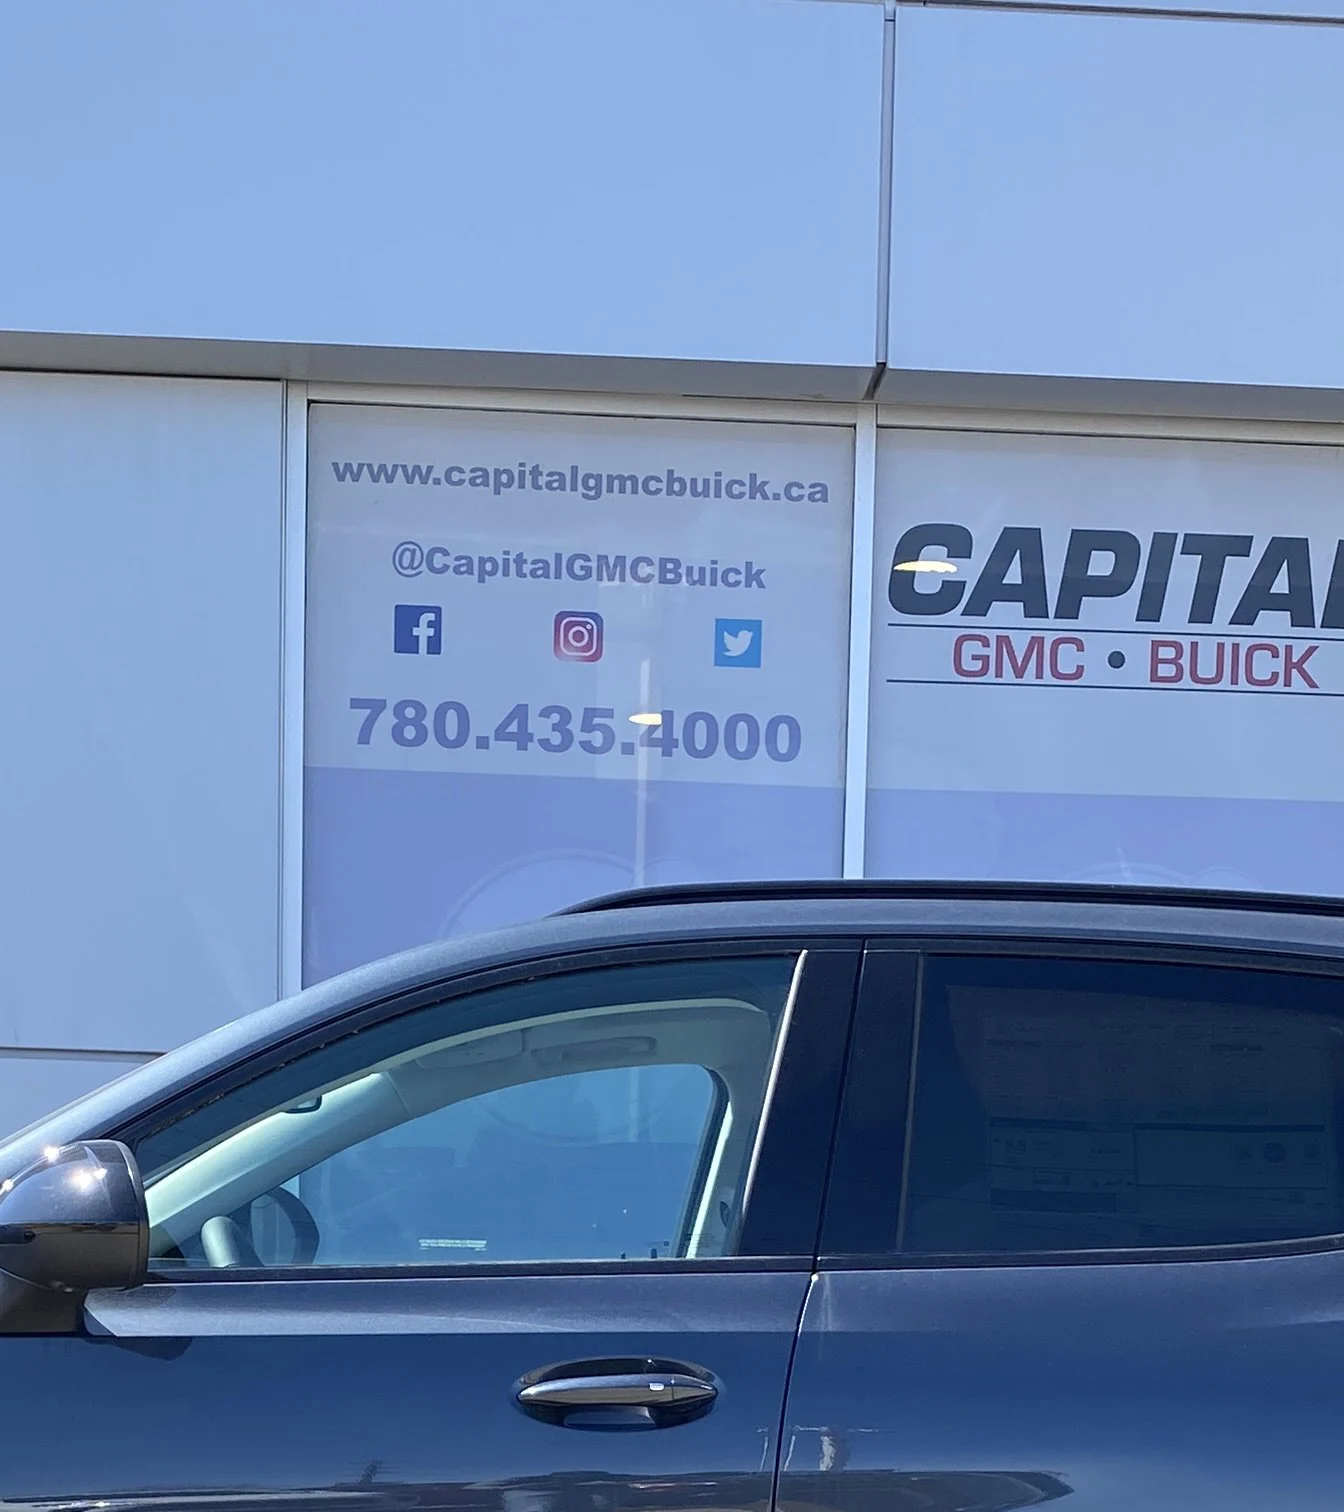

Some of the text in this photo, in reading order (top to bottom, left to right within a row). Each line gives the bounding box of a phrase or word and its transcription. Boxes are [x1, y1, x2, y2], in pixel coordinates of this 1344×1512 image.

[331, 461, 829, 503] www.capitalgmcbuick.ca
[392, 541, 767, 589] @CapitalGMCBuick
[952, 634, 1320, 689] GMC BUICK
[349, 697, 802, 763] 780.435.4000
